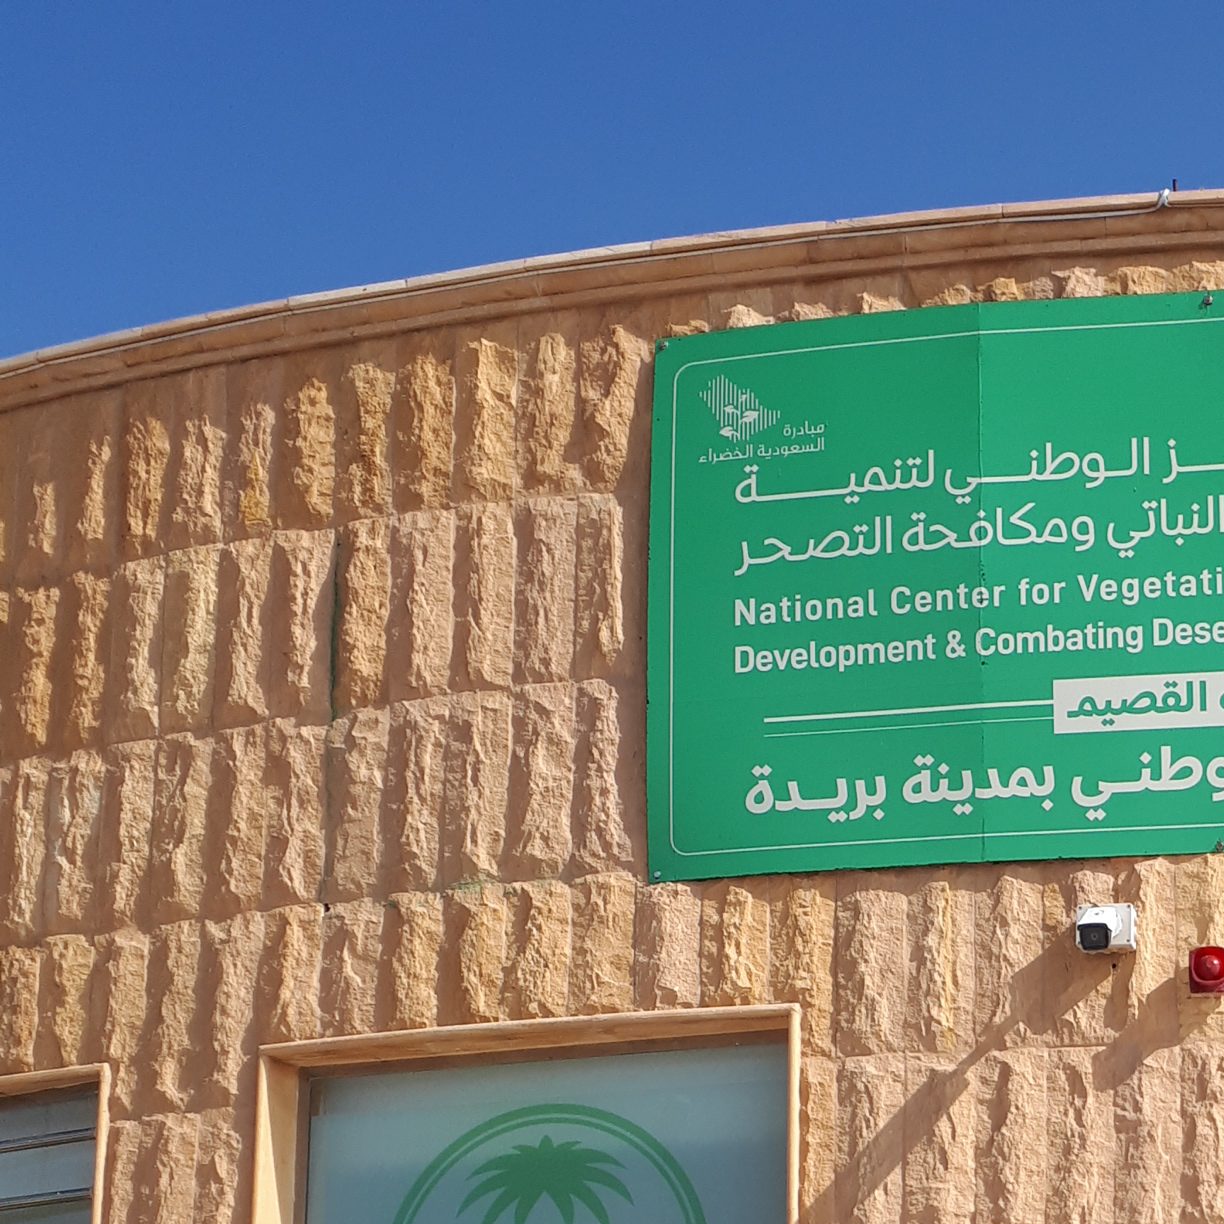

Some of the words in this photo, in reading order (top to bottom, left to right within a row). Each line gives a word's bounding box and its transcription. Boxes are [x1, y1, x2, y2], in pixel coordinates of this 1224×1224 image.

[698, 444, 753, 464] الخضراء
[757, 436, 825, 460] السعودية
[783, 420, 825, 439] مبادرة
[733, 449, 936, 505] لتنمية
[944, 436, 1151, 504] الوطني
[733, 515, 894, 576] التصحر
[901, 502, 1096, 552] ومكافحة
[734, 588, 878, 627] National
[889, 582, 1006, 616] Center
[1018, 577, 1067, 607] for
[734, 631, 937, 674] Development
[944, 629, 967, 658] &
[974, 621, 1144, 657] Combating
[1066, 679, 1208, 727] القصيم
[744, 763, 888, 823] بريدة
[901, 753, 1056, 817] بمدينة
